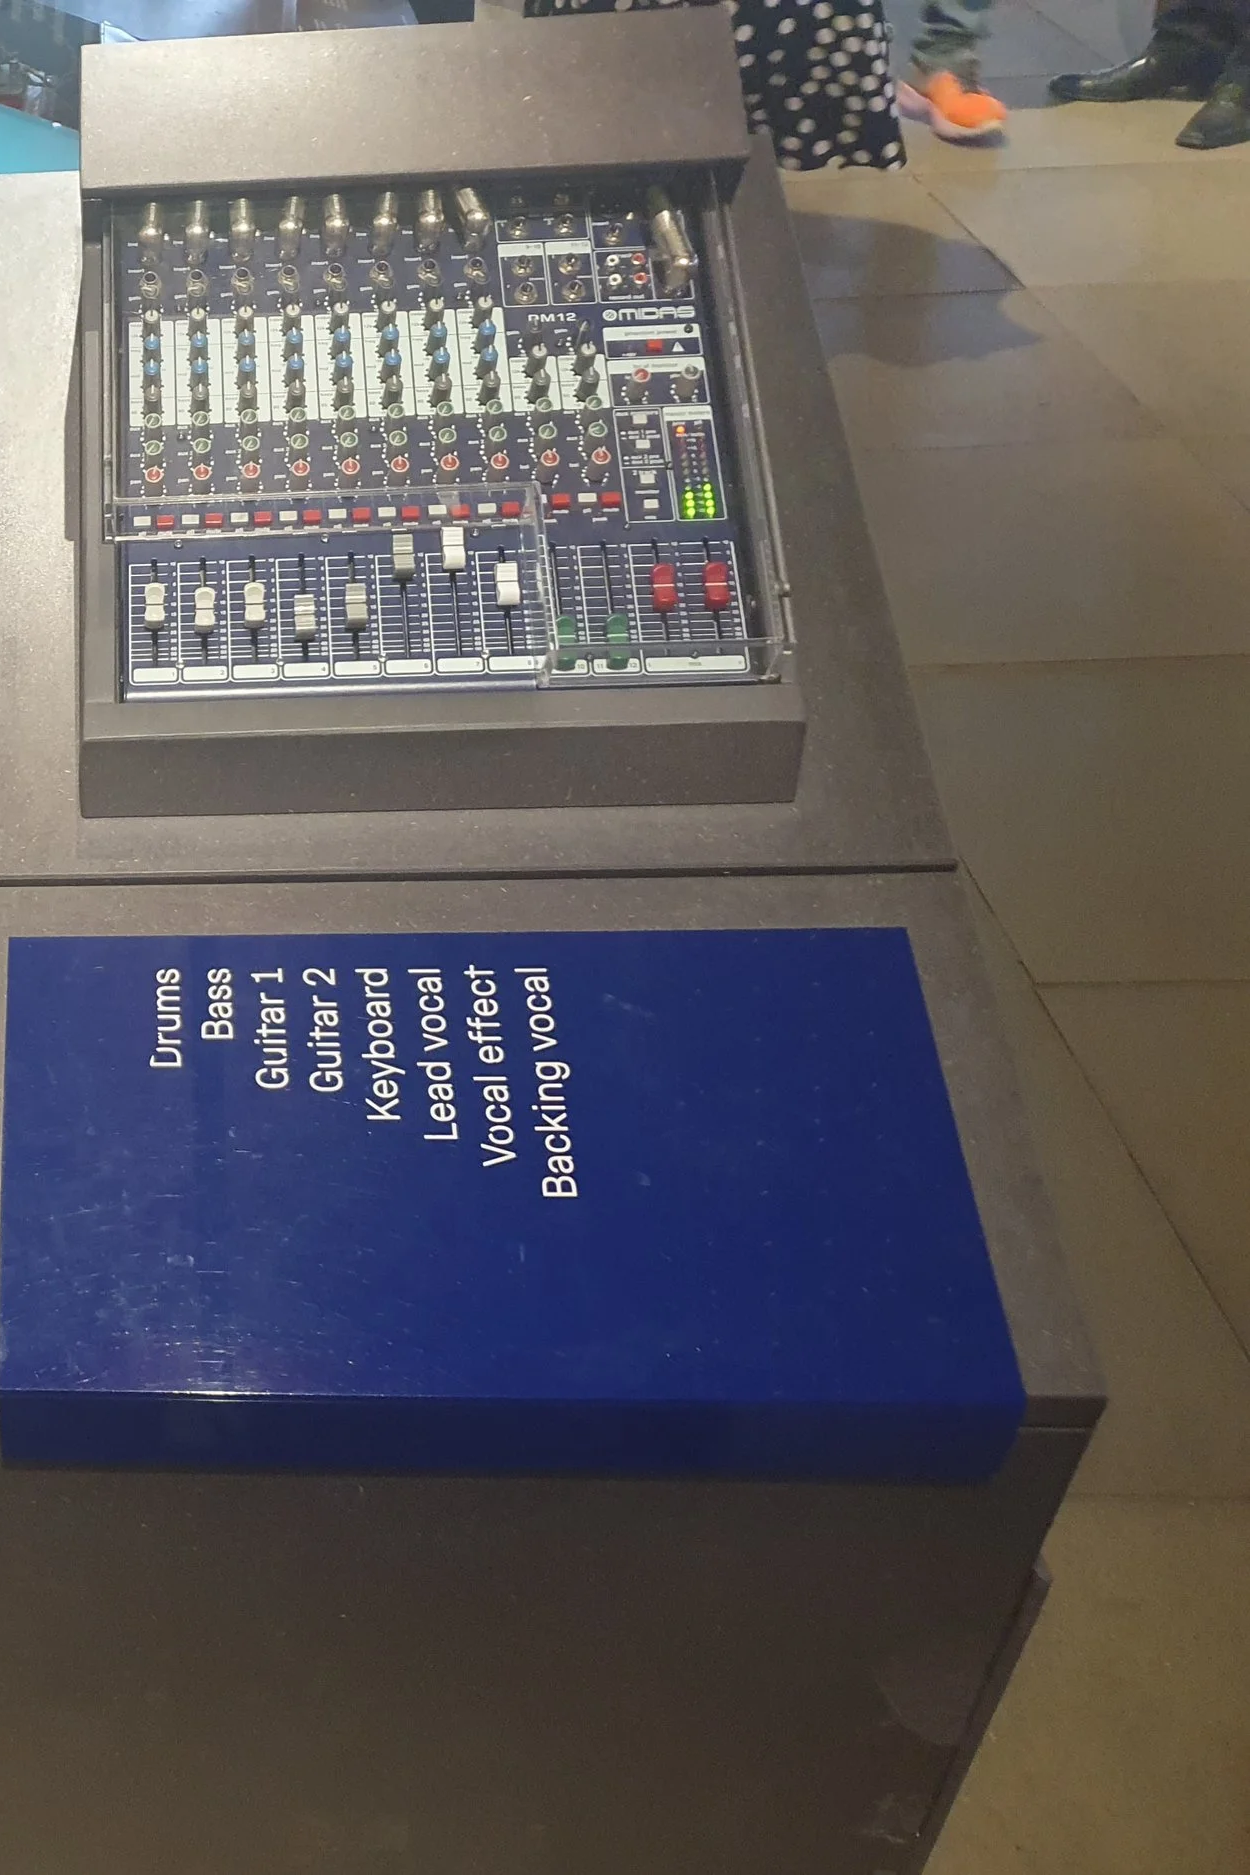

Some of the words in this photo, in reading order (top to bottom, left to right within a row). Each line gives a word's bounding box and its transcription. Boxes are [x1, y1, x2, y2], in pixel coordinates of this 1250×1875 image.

[618, 305, 696, 321] MIDAS
[150, 968, 183, 1068] Drums
[201, 968, 234, 1040] Bass
[250, 967, 284, 983] 1
[302, 968, 336, 986] 2
[407, 968, 449, 1052] vocal
[463, 964, 505, 1064] effect
[513, 967, 558, 1052] vocal
[253, 991, 290, 1089] Guitar
[306, 994, 344, 1092] Guitar
[354, 968, 406, 1120] Keyboard
[416, 1061, 459, 1140] Lead
[472, 1076, 517, 1167] Vocal
[531, 1061, 578, 1197] Backing
